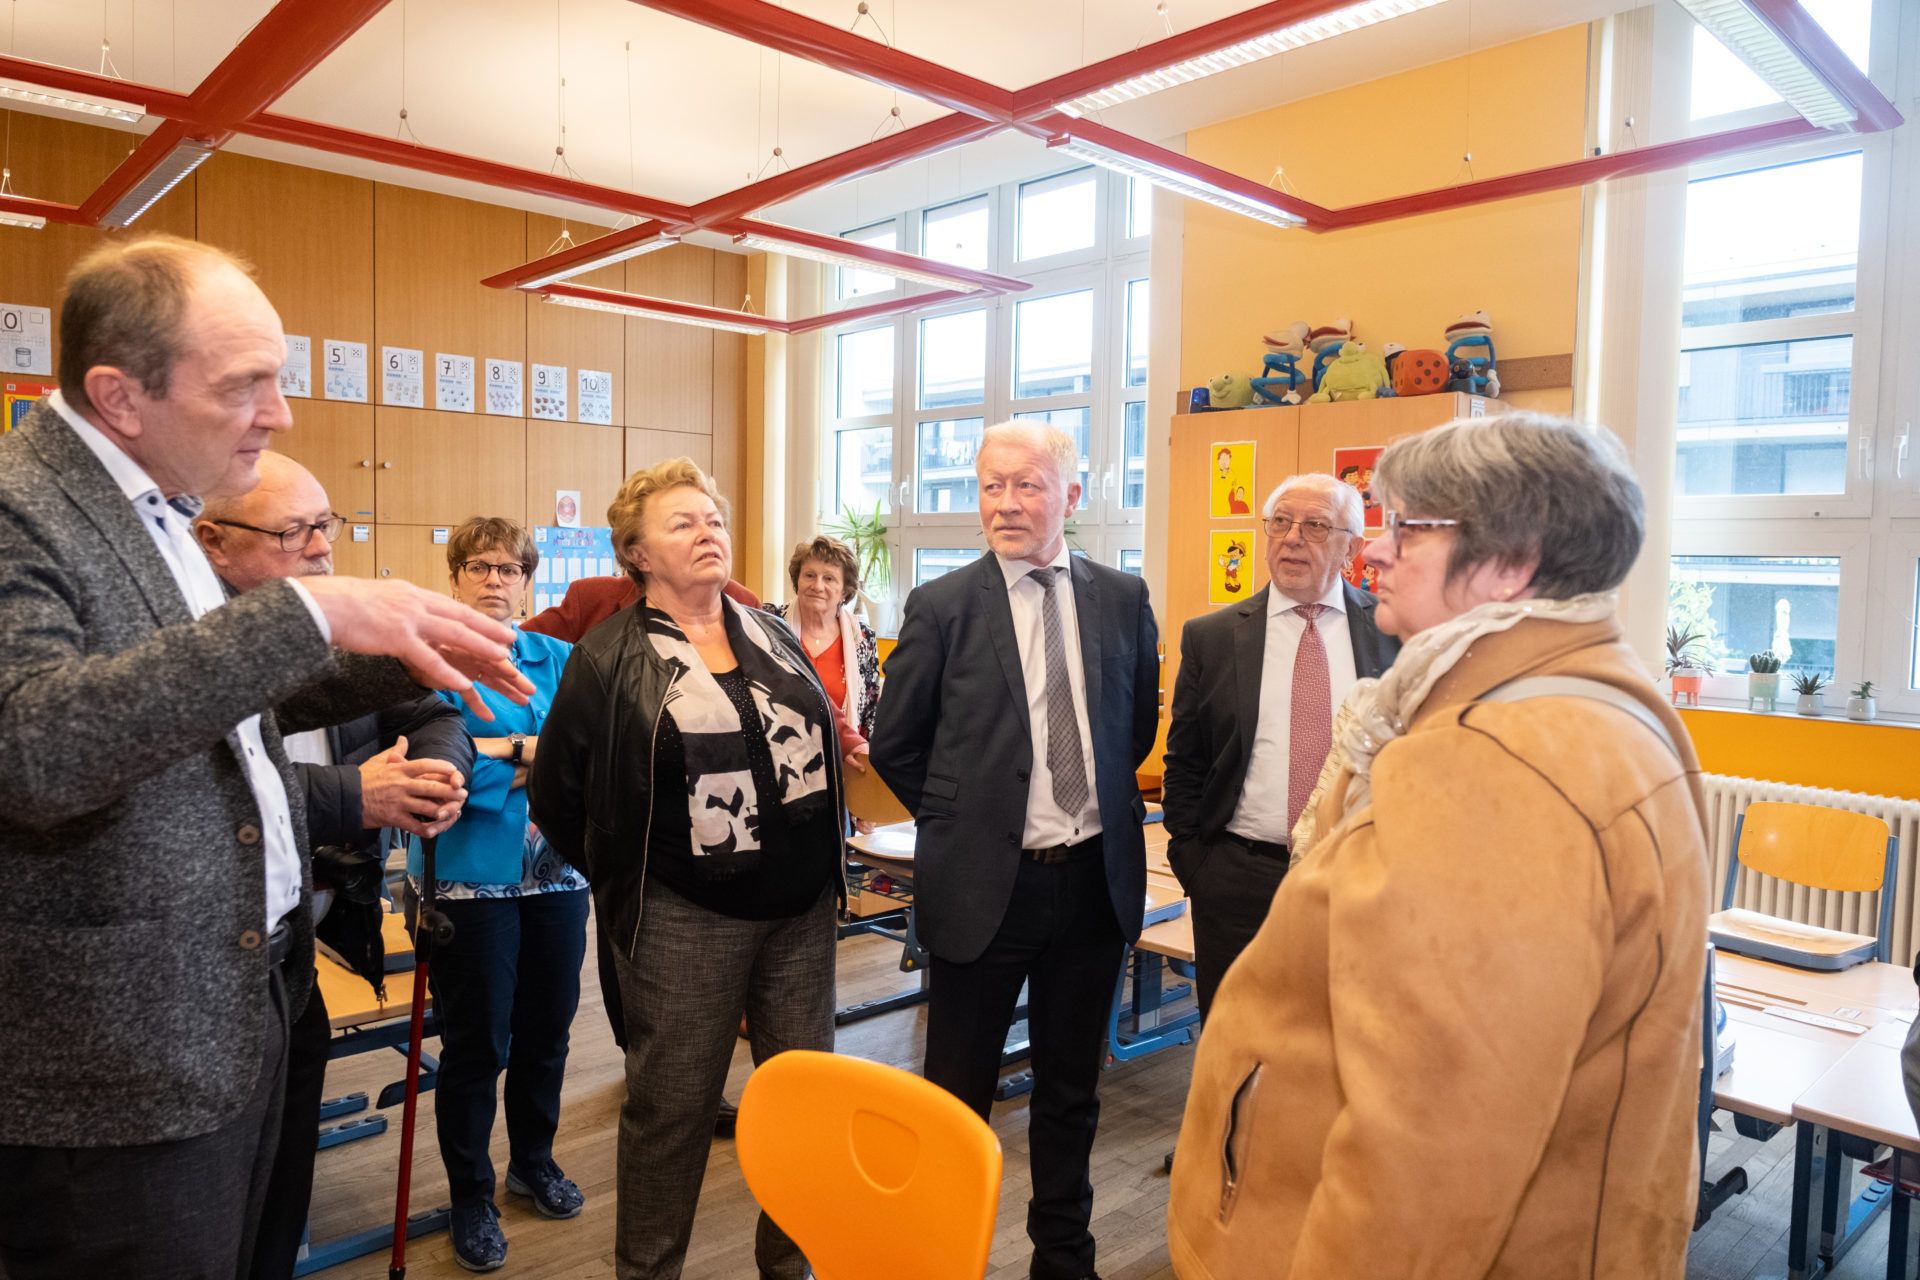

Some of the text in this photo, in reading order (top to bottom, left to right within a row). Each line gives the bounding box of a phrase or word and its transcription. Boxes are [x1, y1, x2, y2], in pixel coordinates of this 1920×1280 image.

[4, 312, 18, 329] 0
[332, 348, 341, 363] 5
[389, 354, 399, 369] 6
[442, 360, 451, 375] 7
[492, 366, 501, 380] 8
[538, 371, 546, 385] 9
[582, 377, 598, 391] 10
